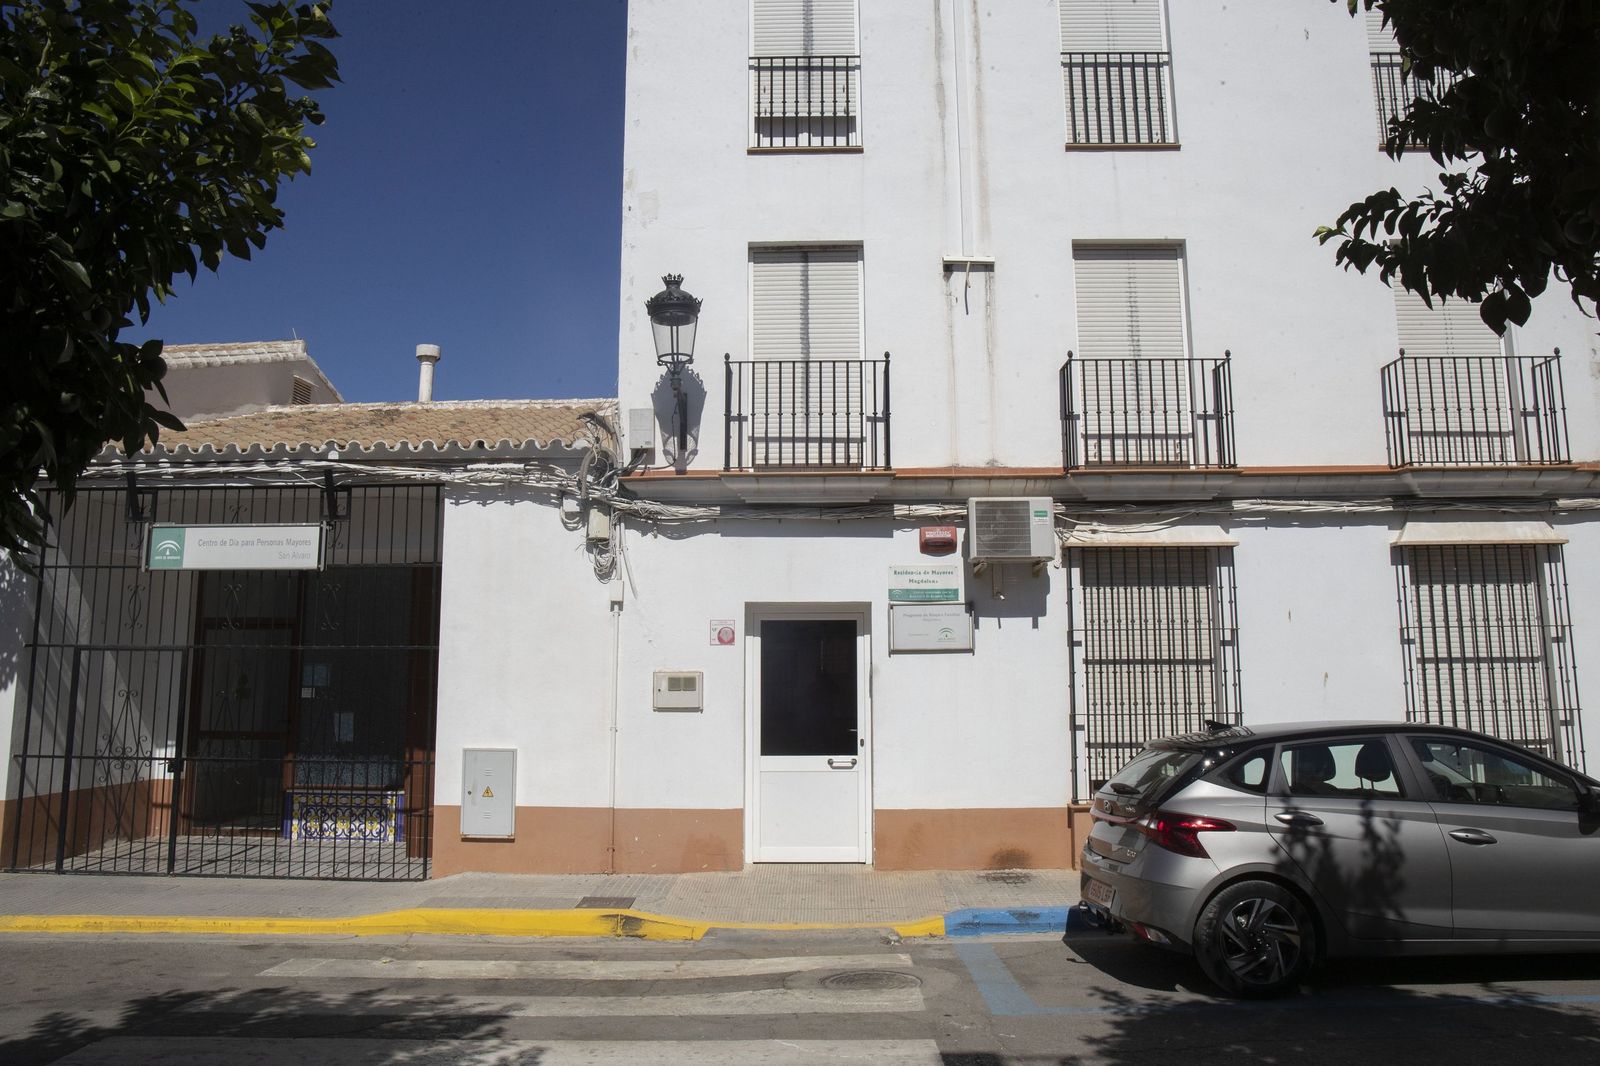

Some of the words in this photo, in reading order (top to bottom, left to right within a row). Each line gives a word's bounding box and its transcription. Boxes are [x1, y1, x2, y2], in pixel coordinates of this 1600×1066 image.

[197, 538, 218, 547] Centro
[219, 538, 228, 547] de
[240, 540, 255, 549] para
[256, 538, 284, 547] Personas
[285, 538, 312, 548] Mayores
[278, 551, 290, 560] San
